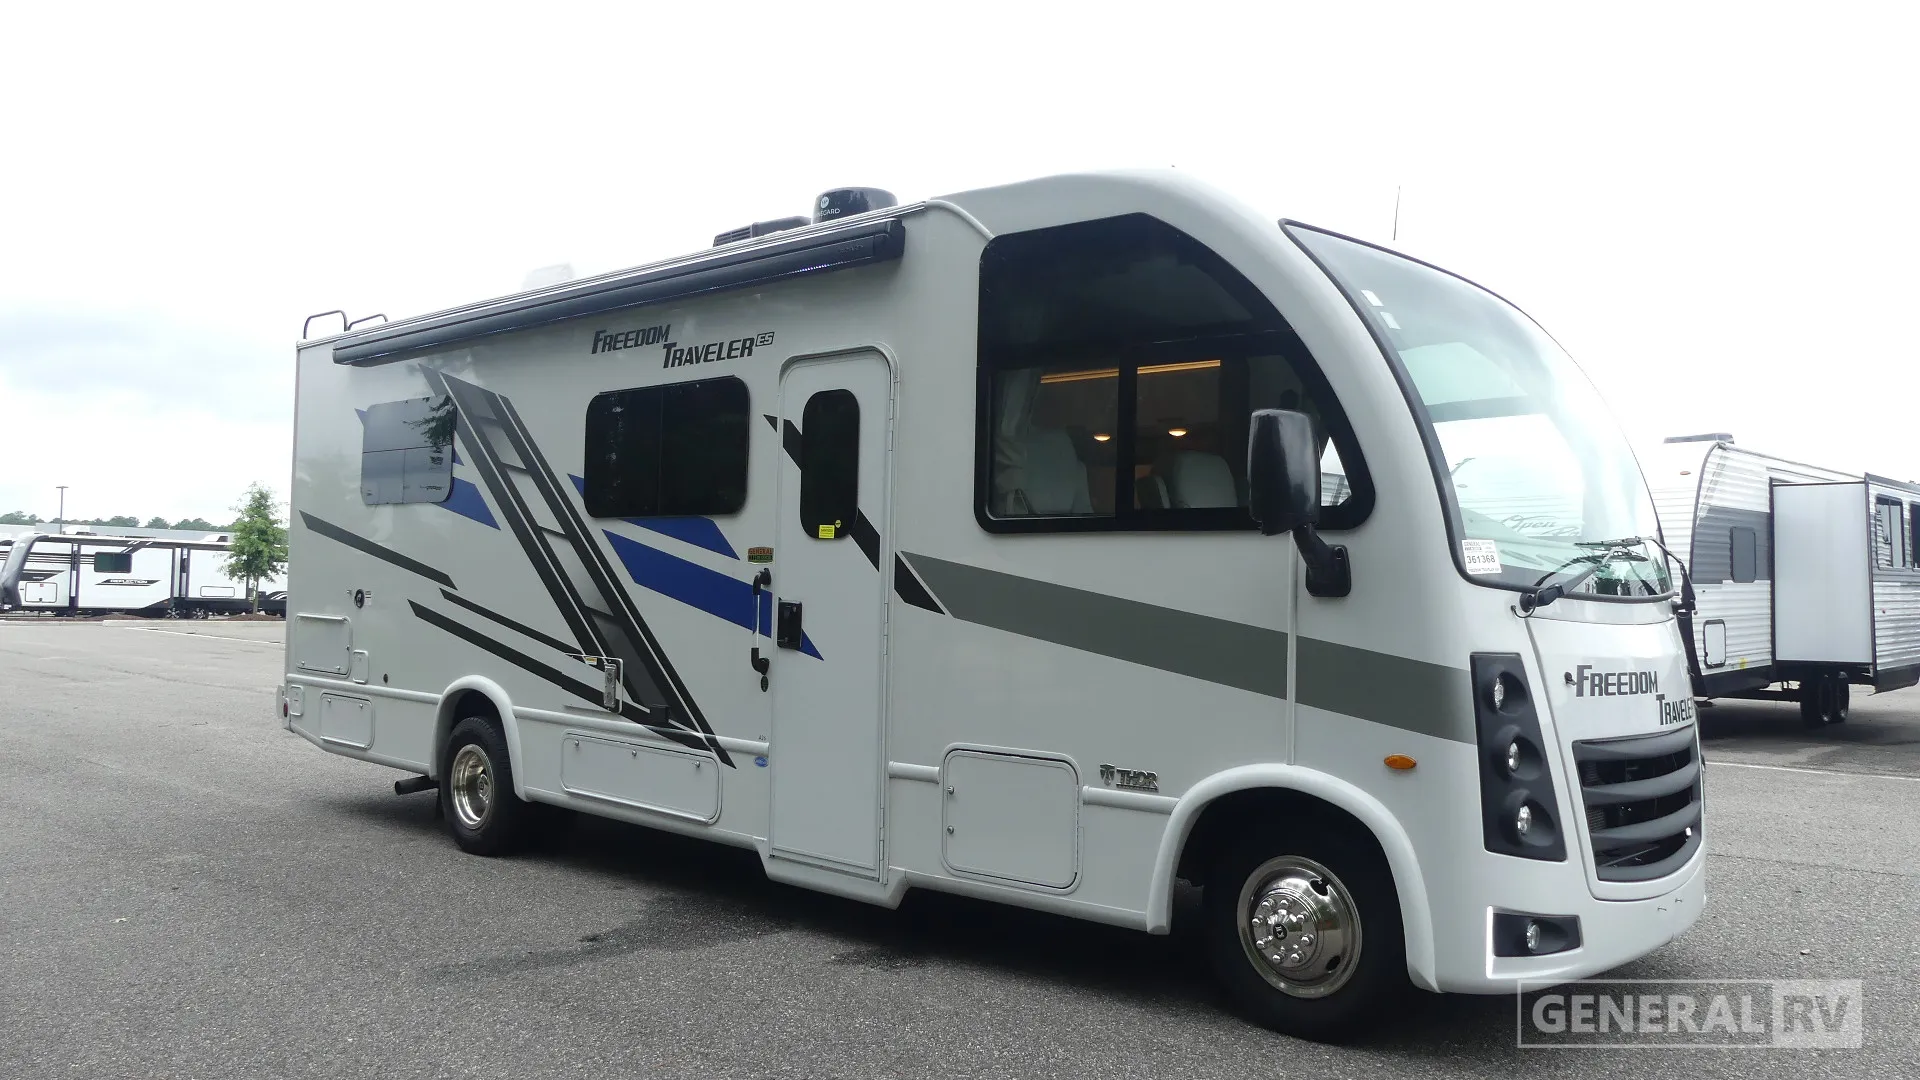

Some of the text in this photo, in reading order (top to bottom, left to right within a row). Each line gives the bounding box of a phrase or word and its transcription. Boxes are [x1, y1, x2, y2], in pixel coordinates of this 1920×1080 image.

[591, 324, 671, 354] FREEDOM
[663, 333, 774, 368] TRAVELER ES
[1576, 665, 1658, 697] FREEDOM
[1116, 768, 1158, 792] THOR
